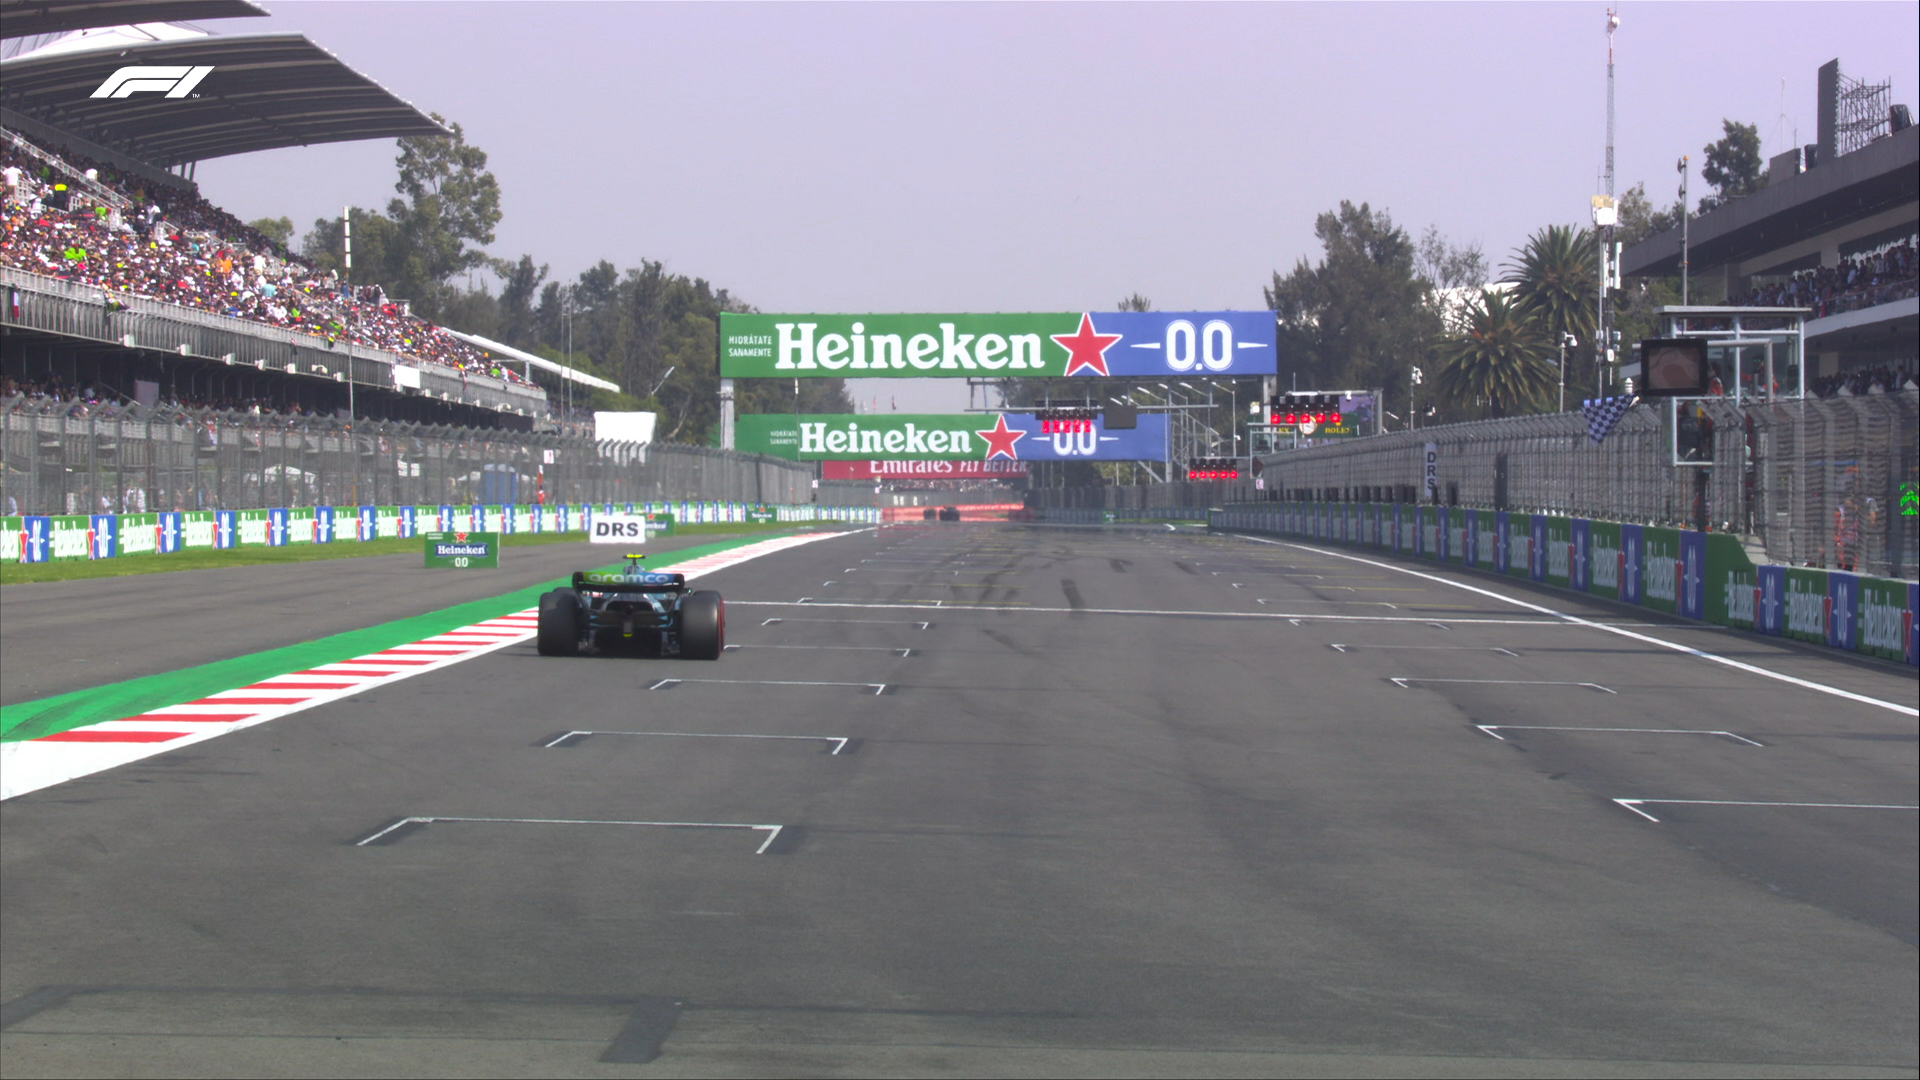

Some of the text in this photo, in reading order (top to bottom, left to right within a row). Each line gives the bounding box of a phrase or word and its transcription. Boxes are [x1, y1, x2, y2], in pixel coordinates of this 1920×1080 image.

[728, 334, 772, 345] HIDRÁTATE
[775, 319, 1234, 372] Heineken 0.0
[728, 347, 772, 357] SANAMENTE
[800, 422, 972, 453] Heineken
[870, 460, 953, 474] Emirates
[1427, 451, 1437, 489] DRS
[596, 522, 639, 537] DRS
[437, 544, 486, 555] Heineken
[588, 573, 669, 584] aramco
